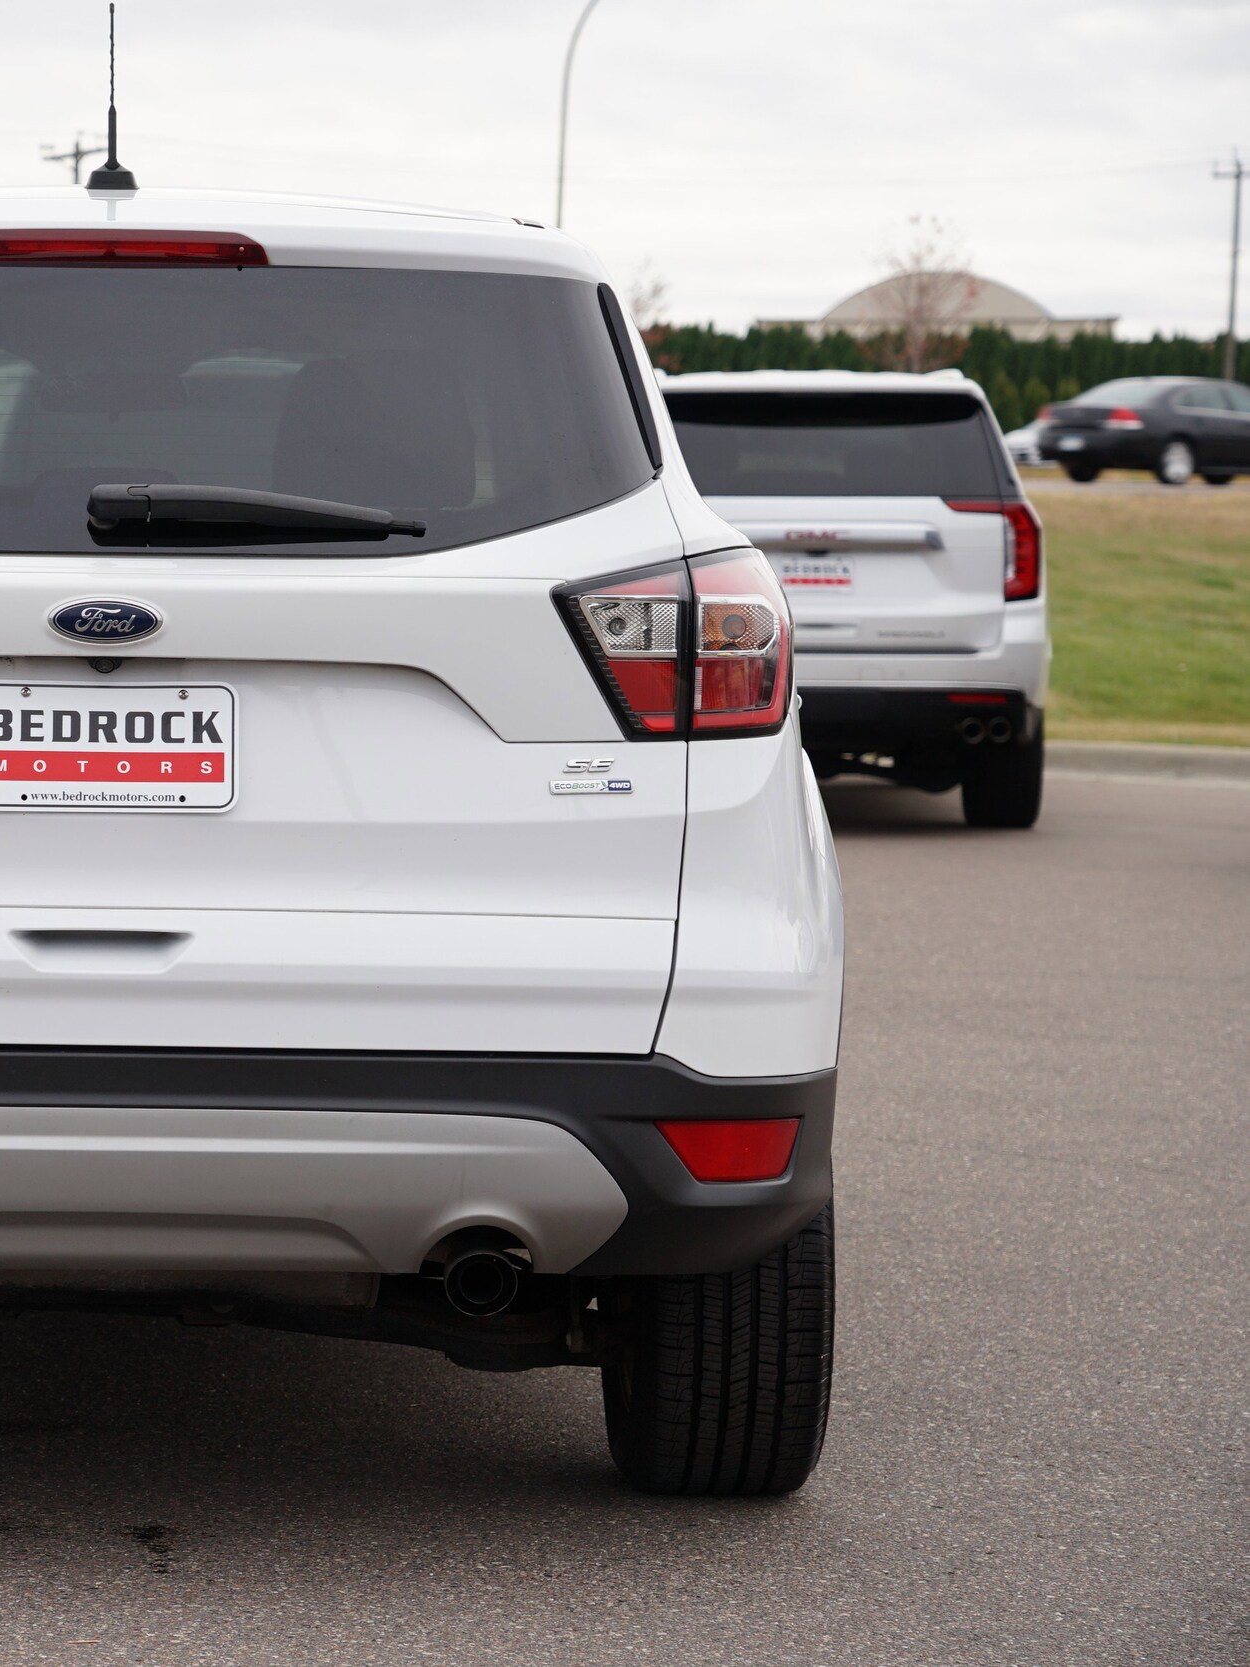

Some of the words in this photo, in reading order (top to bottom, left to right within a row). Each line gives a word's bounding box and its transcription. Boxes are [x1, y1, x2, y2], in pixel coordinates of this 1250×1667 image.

[74, 607, 137, 633] Ford
[562, 757, 615, 774] SE
[554, 782, 601, 790] ECOBOOST
[30, 791, 176, 803] www.bedrockmotors.com
